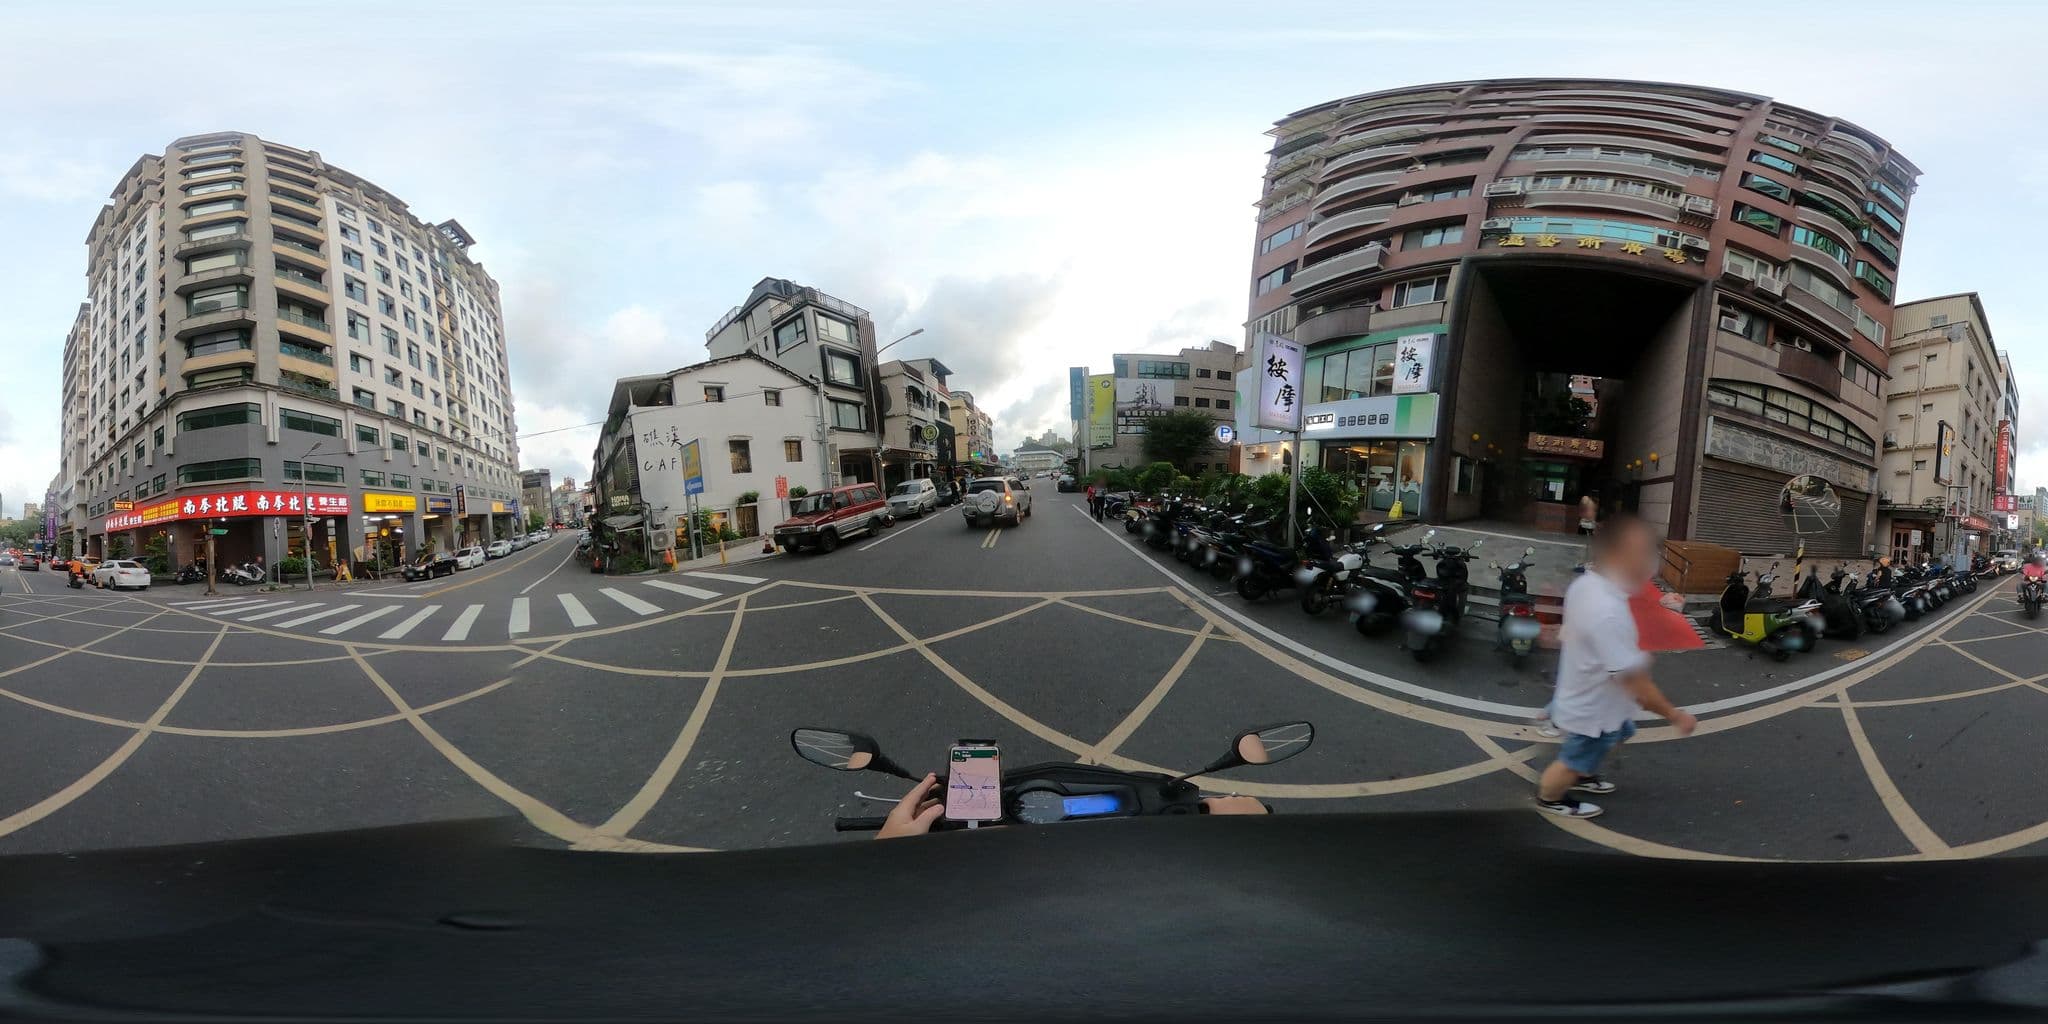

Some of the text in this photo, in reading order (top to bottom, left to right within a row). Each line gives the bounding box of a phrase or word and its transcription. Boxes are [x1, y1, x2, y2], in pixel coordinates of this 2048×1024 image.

[1401, 346, 1423, 383] 按摩
[1267, 353, 1296, 412] 按摩
[643, 426, 682, 448] 礁溪
[1220, 427, 1230, 437] P
[644, 458, 678, 472] CAF
[183, 495, 248, 514] 南拳北腿
